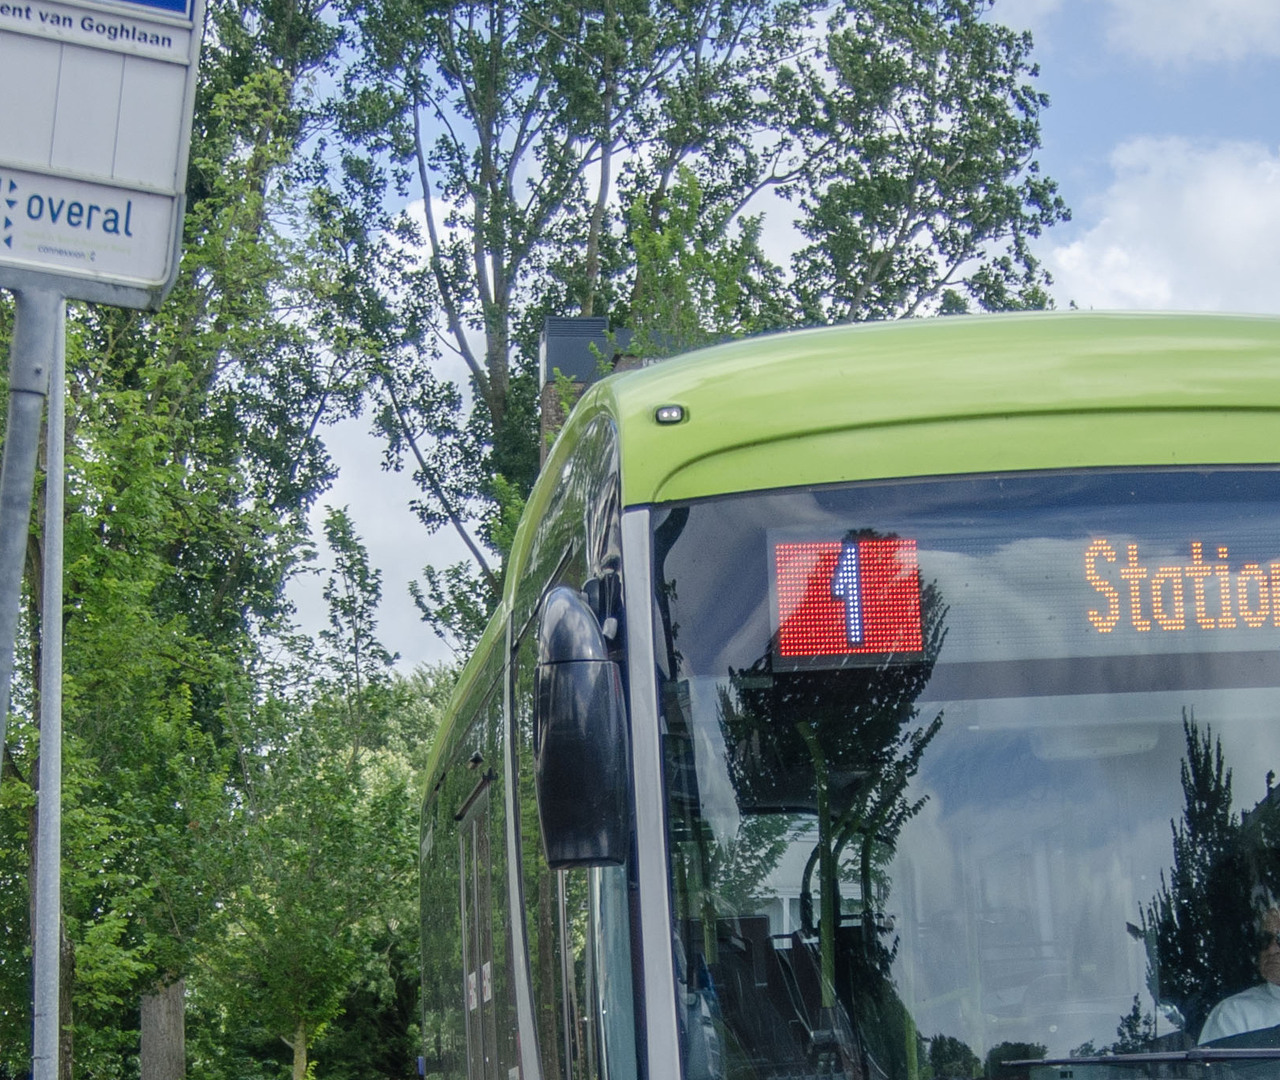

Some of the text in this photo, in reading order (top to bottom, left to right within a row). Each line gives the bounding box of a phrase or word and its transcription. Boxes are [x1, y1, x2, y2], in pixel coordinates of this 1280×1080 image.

[39, 11, 73, 28] van
[81, 17, 173, 48] Goghlaan
[26, 194, 132, 237] overal
[831, 543, 863, 644] 1
